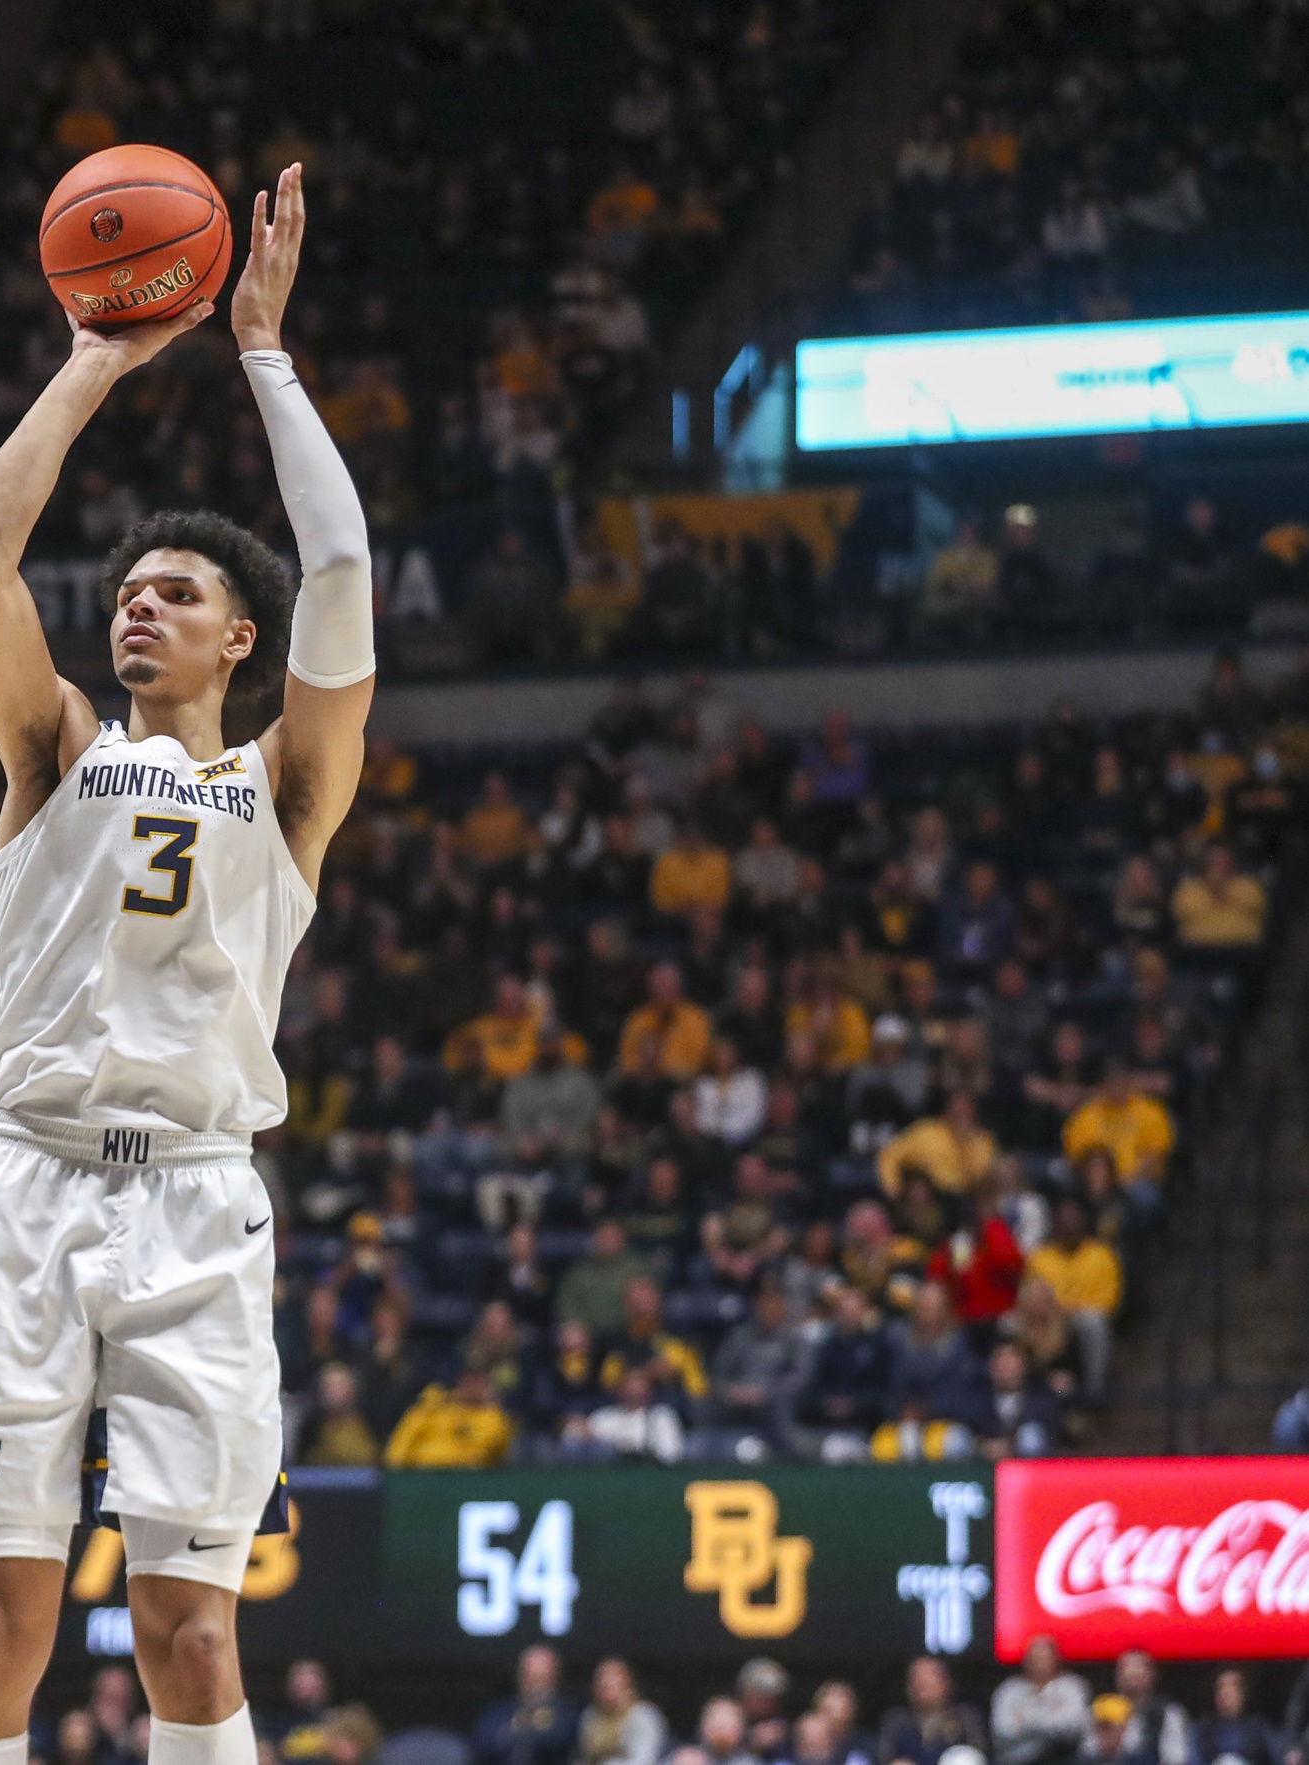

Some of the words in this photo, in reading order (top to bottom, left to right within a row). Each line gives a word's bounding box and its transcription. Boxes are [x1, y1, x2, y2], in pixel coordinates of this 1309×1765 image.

[70, 257, 195, 316] SPALDING
[78, 763, 256, 823] MOUNTANEERS
[121, 814, 200, 918] 3
[102, 1128, 150, 1164] WVU
[457, 1500, 580, 1637] 54
